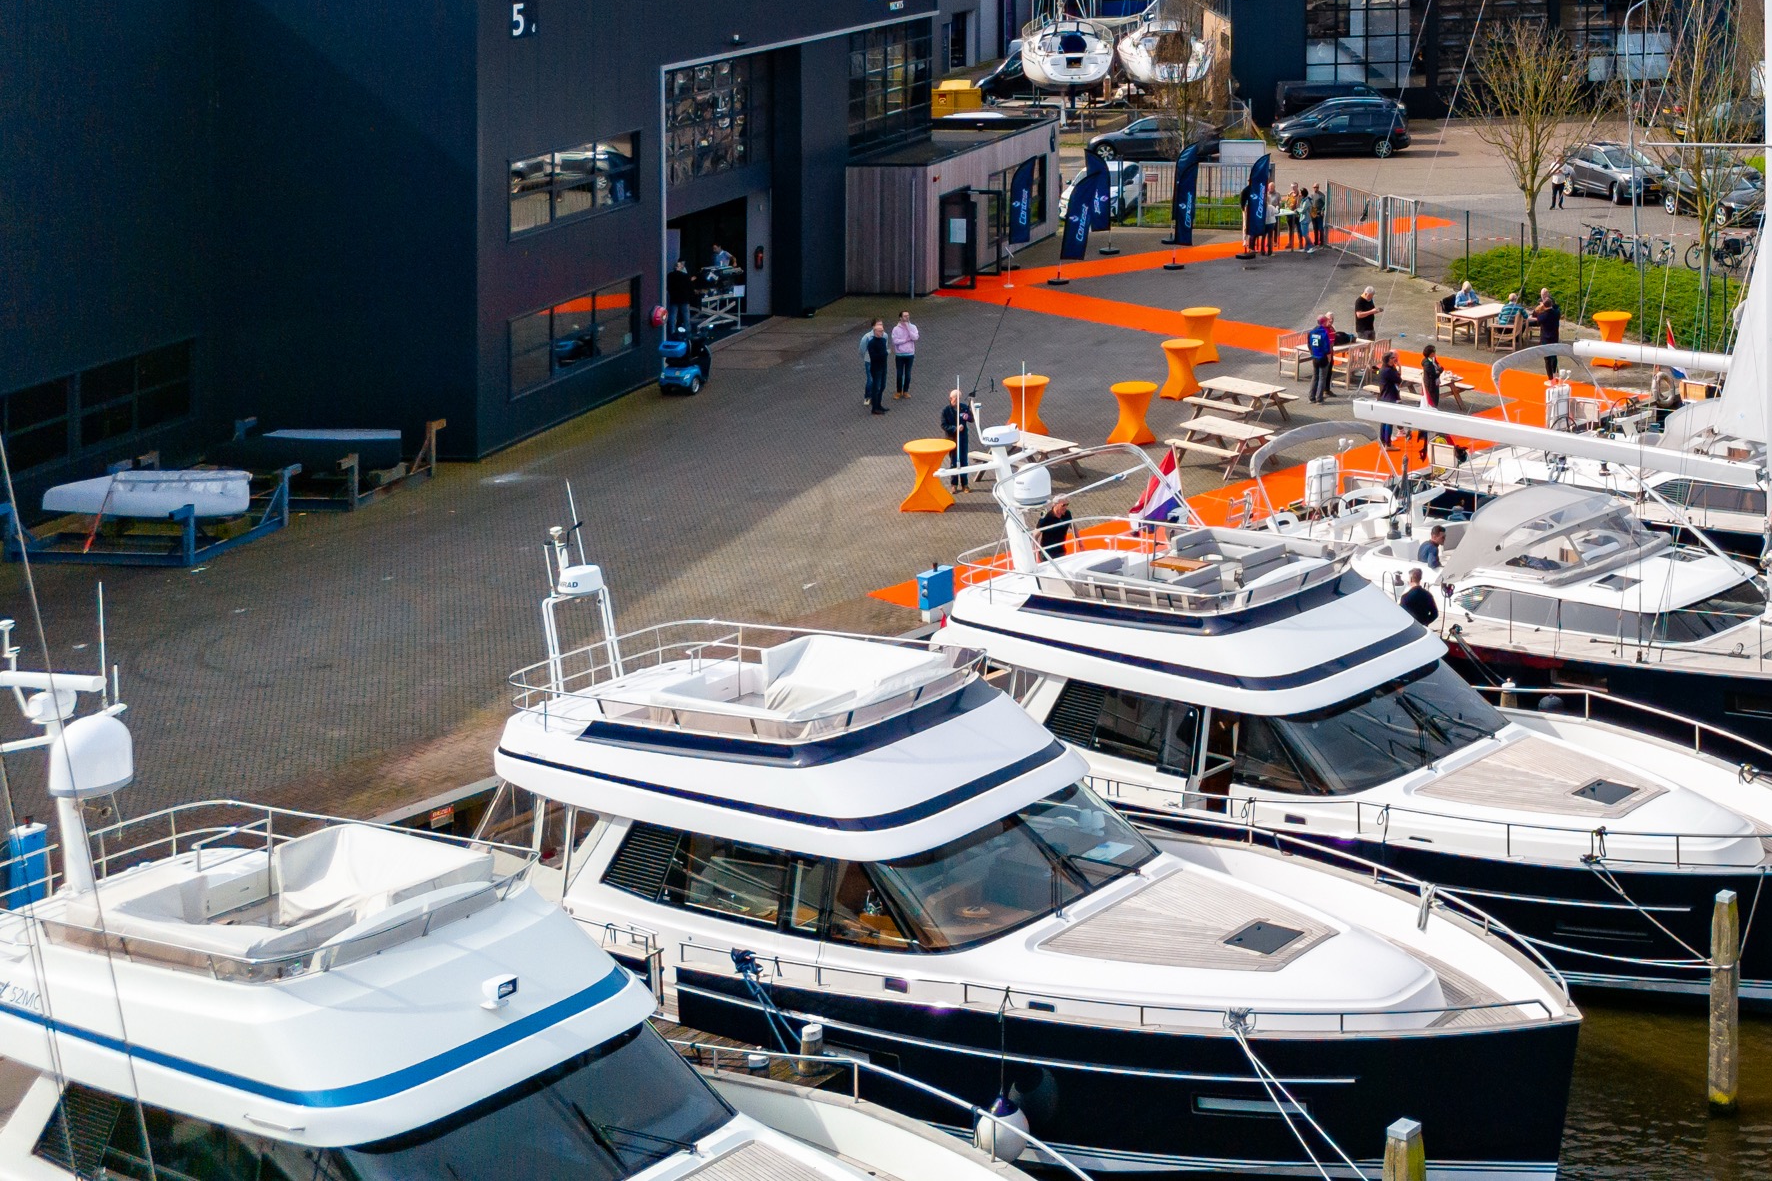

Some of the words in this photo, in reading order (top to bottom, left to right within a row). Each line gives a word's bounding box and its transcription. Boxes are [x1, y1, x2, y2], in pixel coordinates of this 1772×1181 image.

[512, 2, 525, 36] 5
[1019, 188, 1029, 226] Contest
[1075, 203, 1089, 242] Contest
[1185, 191, 1193, 228] Contest
